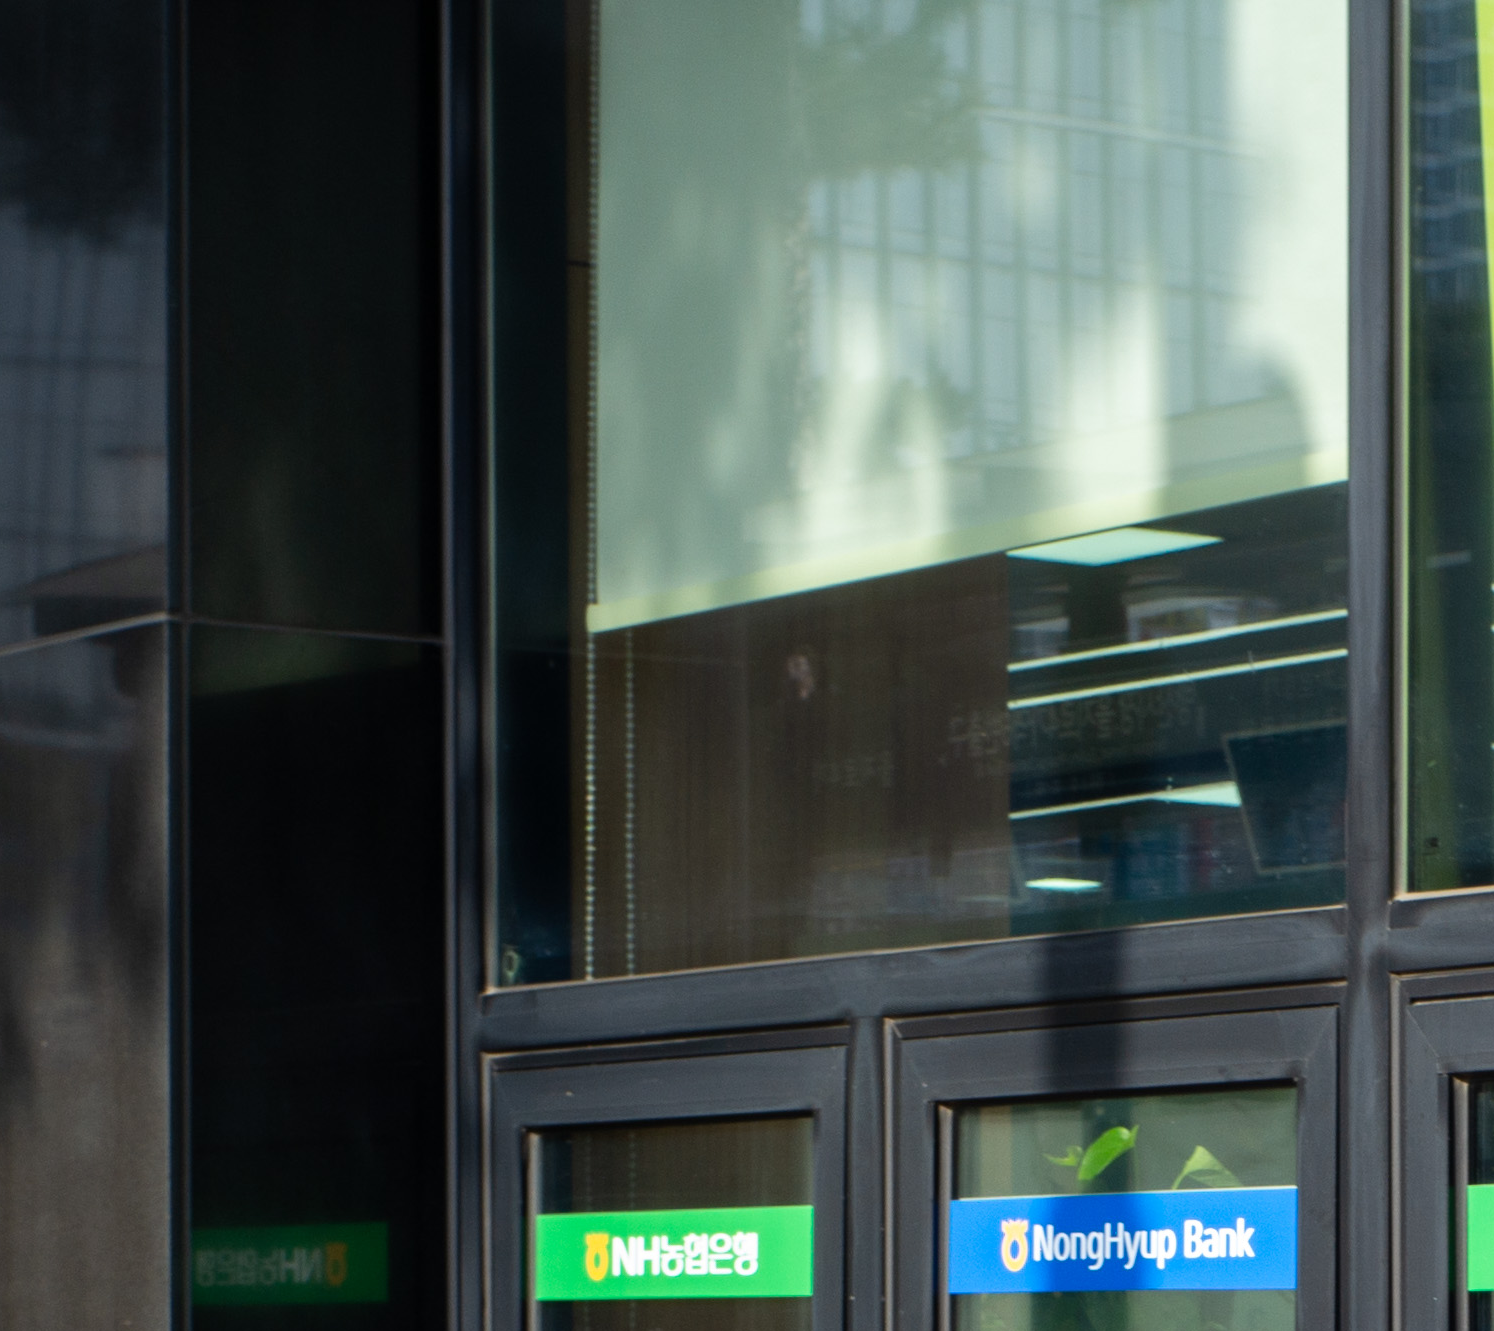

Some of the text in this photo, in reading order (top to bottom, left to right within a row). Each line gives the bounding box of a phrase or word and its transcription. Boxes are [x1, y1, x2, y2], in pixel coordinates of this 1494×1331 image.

[611, 1231, 759, 1278] NH농협은행
[1032, 1218, 1256, 1273] NongHyup Bank
